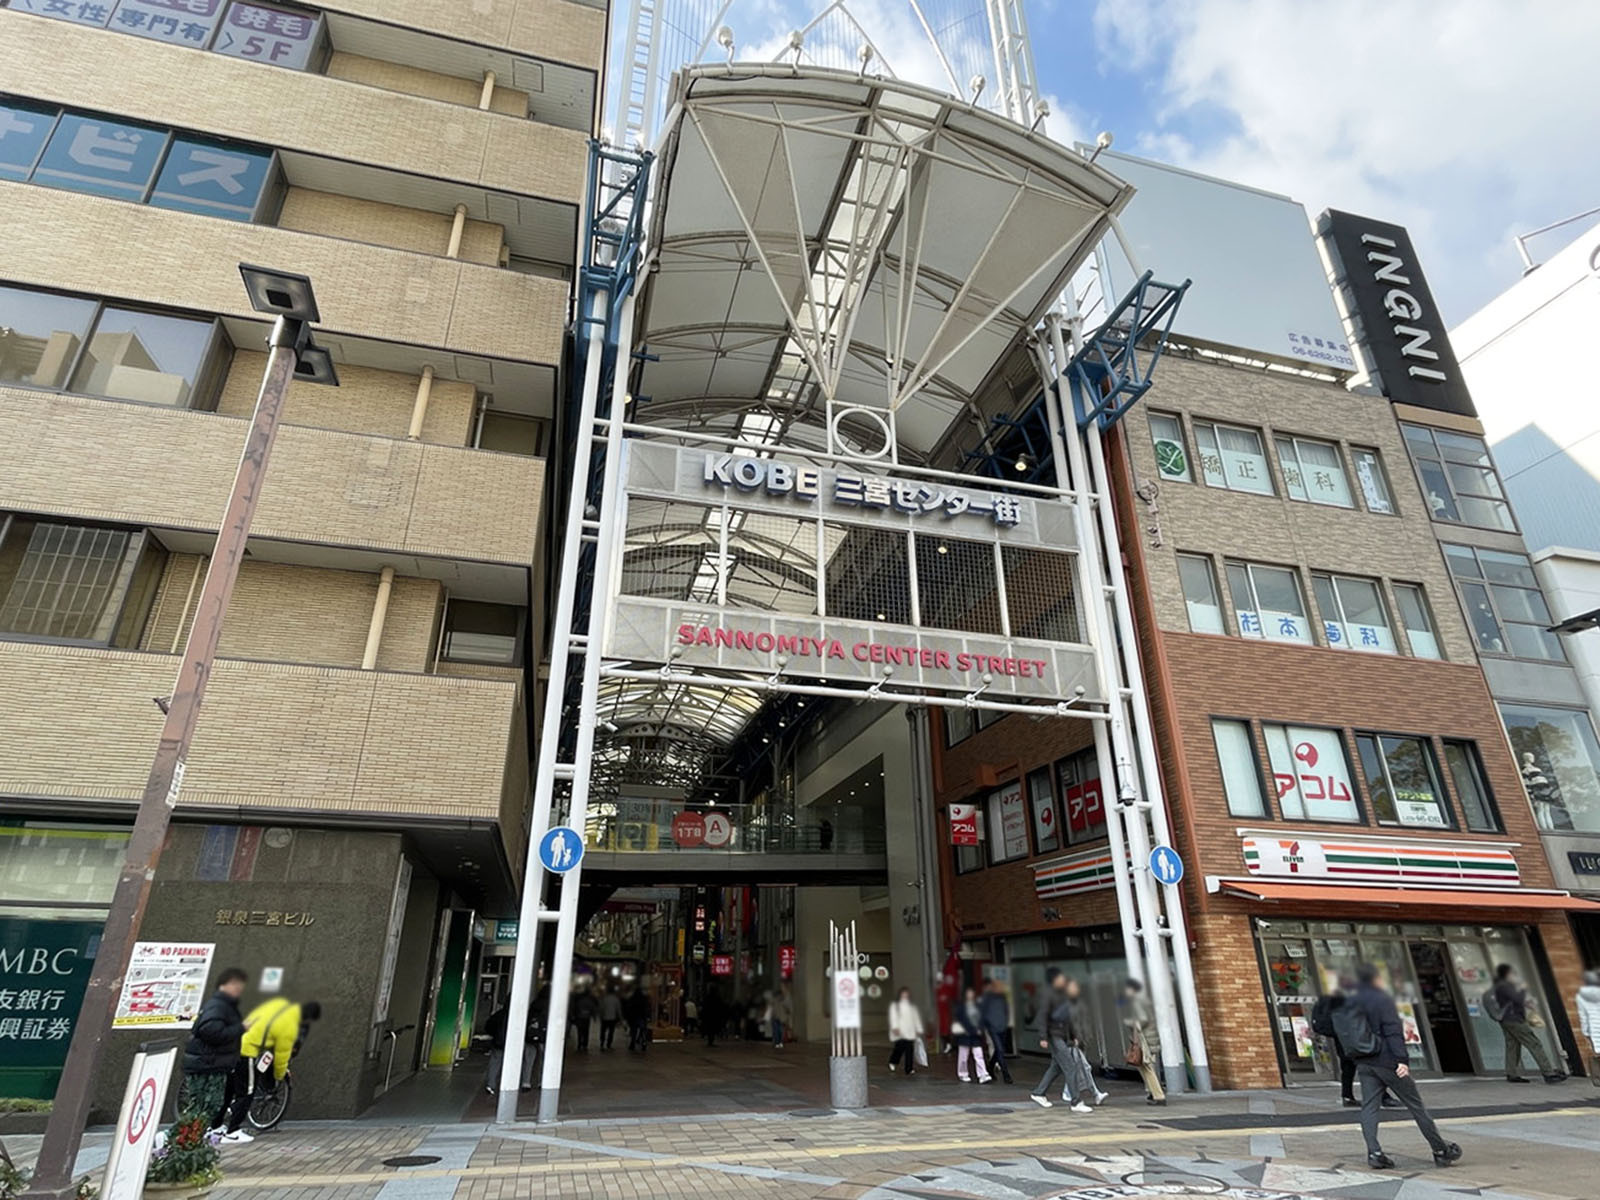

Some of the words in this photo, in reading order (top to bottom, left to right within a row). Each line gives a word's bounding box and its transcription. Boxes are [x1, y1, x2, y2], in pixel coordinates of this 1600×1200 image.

[239, 7, 304, 37] 発毛
[241, 37, 293, 61] 5F
[1360, 233, 1447, 381] INGNI
[704, 453, 818, 496] KOBE
[834, 472, 1022, 528] 三宮センター街
[677, 624, 846, 660] SANNOMIYA
[852, 641, 950, 670] CENTER
[956, 652, 1047, 678] STREET
[1274, 773, 1352, 801] アコム
[710, 820, 722, 833] A
[952, 823, 976, 833] アコム
[215, 909, 315, 927] 銀泉三宮ビル
[160, 947, 171, 956] NO
[172, 947, 209, 956] PARKING!
[0, 988, 66, 1011] 友銀行
[0, 1017, 71, 1040] 興証券
